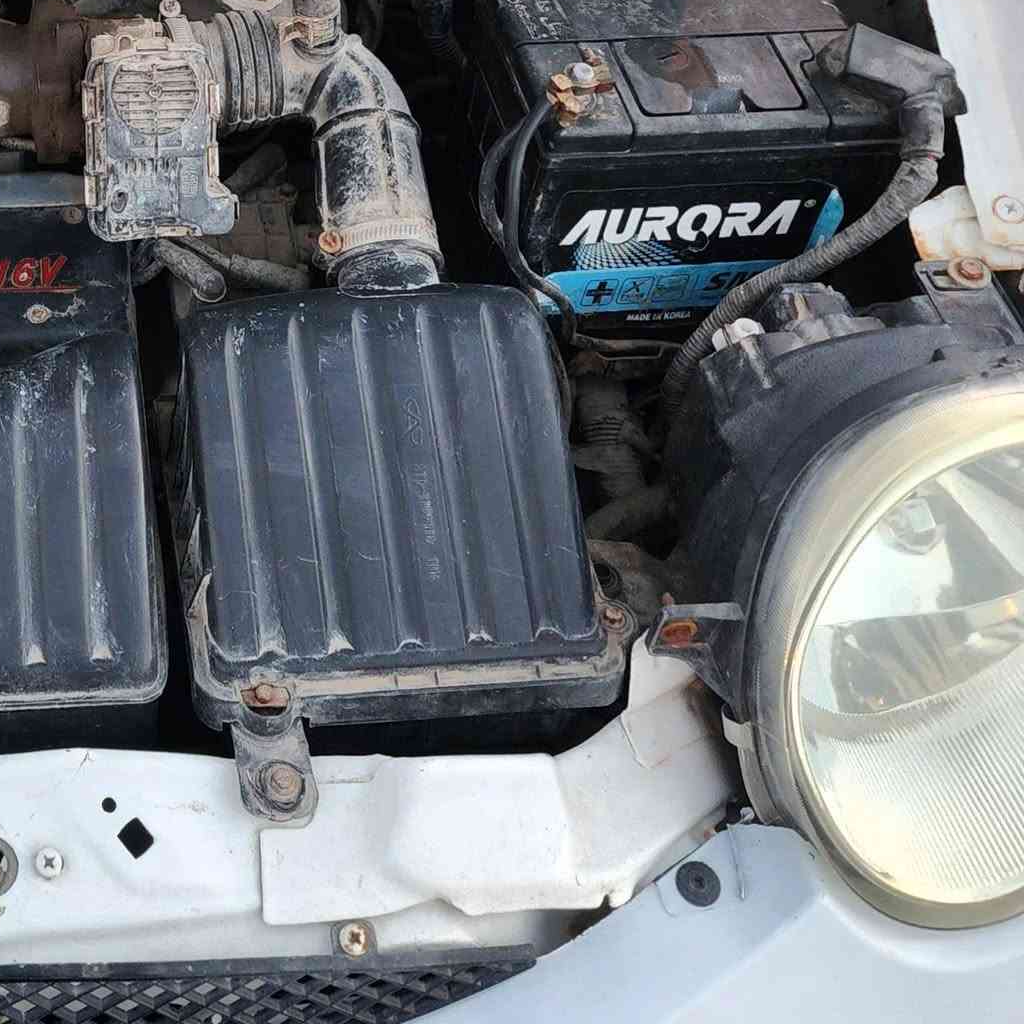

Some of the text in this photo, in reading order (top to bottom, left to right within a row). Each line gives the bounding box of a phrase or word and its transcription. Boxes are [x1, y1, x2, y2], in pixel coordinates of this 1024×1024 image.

[559, 199, 801, 247] AURORA
[626, 312, 651, 321] MADE
[663, 311, 692, 320] KOREA
